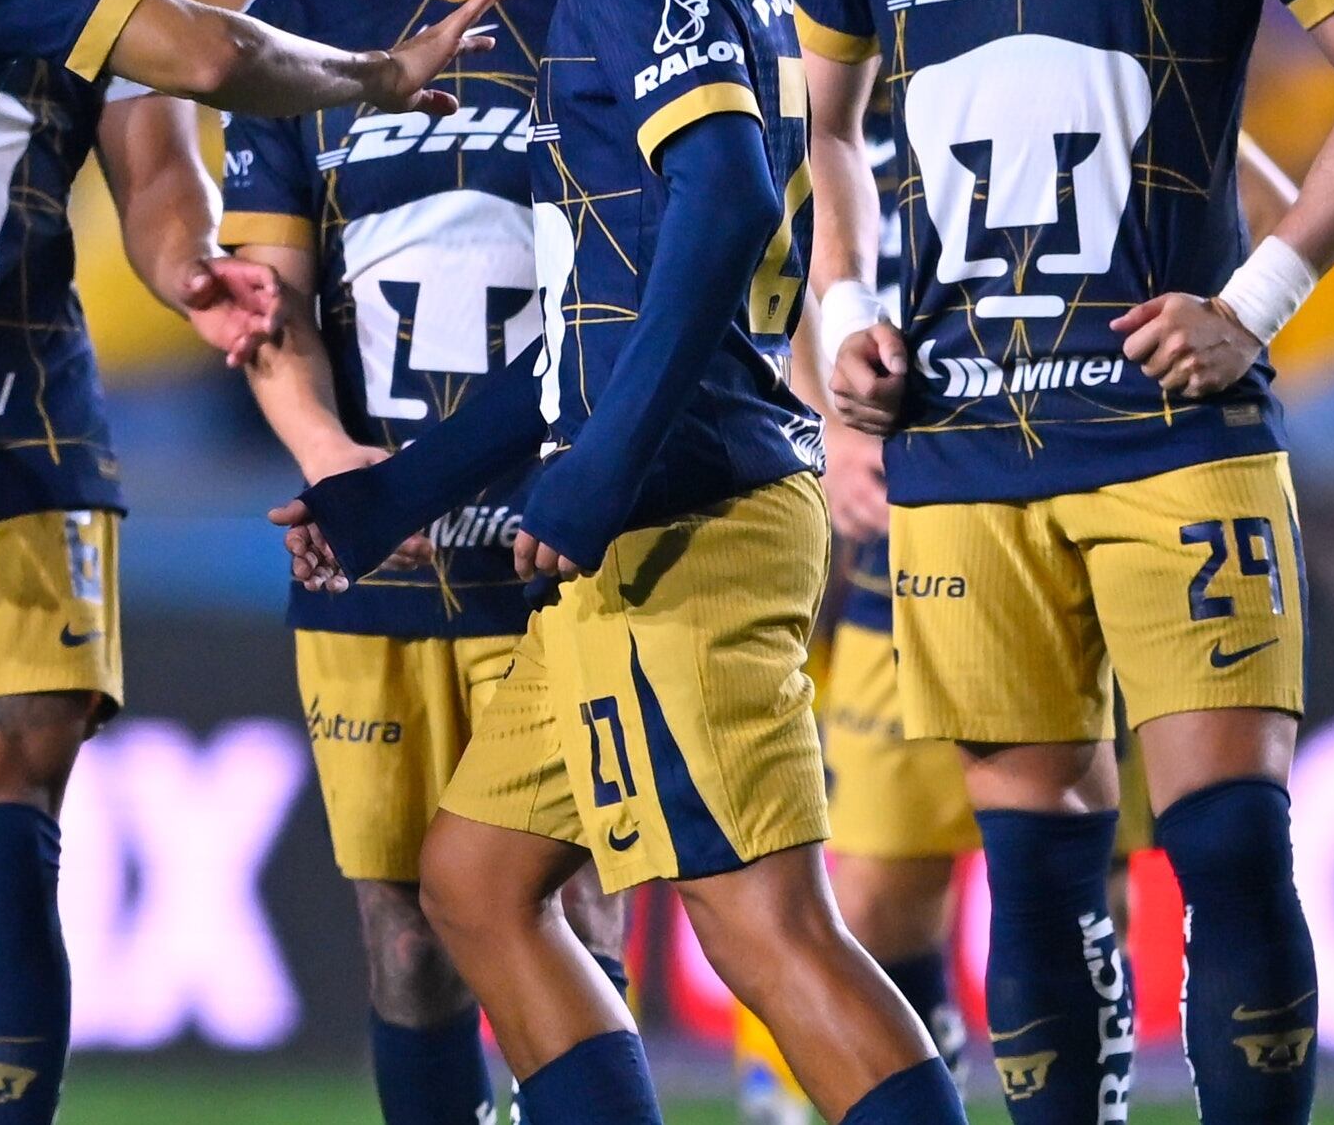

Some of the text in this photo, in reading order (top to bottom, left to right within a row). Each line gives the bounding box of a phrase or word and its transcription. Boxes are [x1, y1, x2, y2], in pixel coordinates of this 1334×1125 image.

[634, 40, 745, 100] RALOY
[1010, 356, 1125, 393] Mifel
[430, 506, 522, 548] Mife
[895, 569, 966, 598] tura
[1179, 516, 1286, 622] 29
